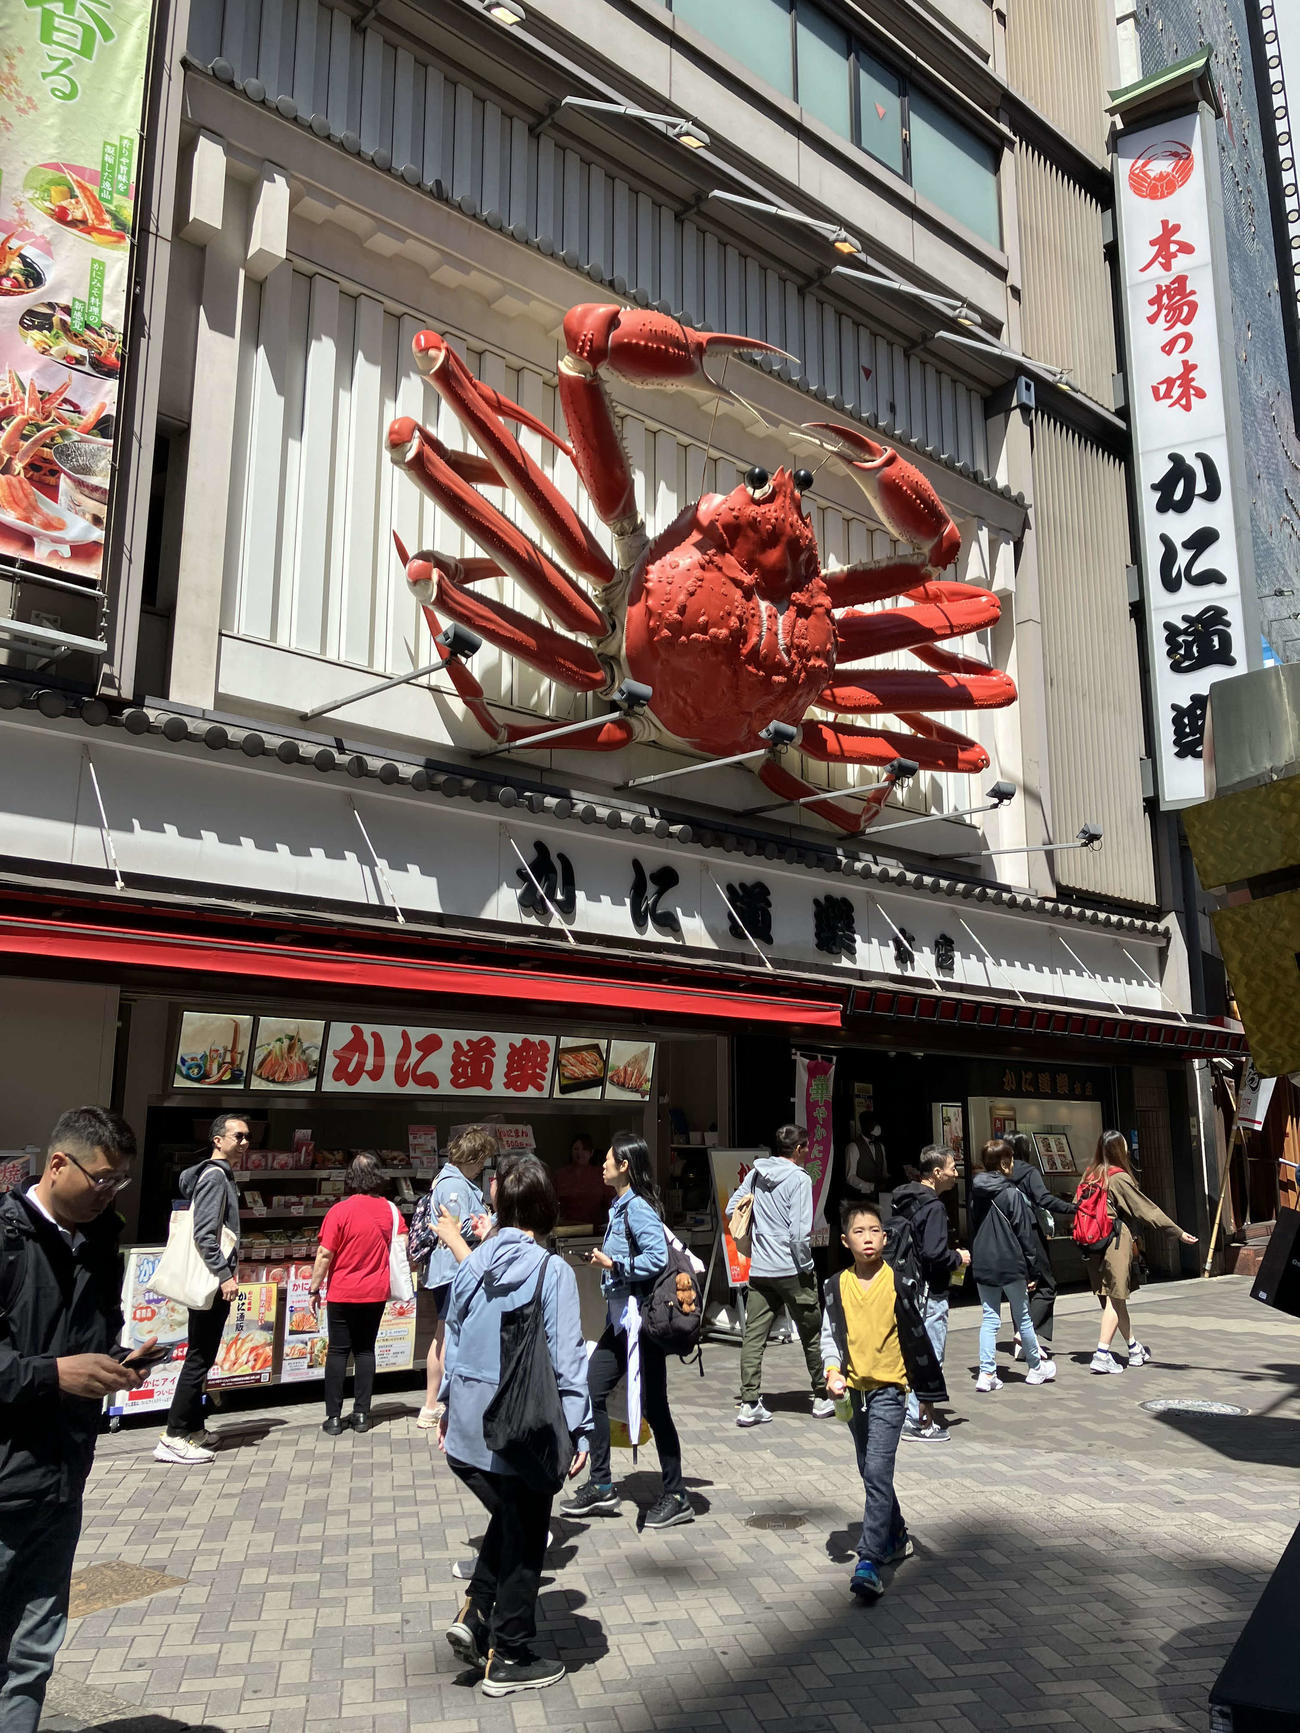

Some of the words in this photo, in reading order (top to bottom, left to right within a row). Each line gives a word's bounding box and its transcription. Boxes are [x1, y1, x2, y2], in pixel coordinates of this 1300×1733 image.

[89, 263, 103, 323] かにみそ料理の
[1139, 219, 1206, 412] 本場の味
[235, 1291, 247, 1332] かに通販
